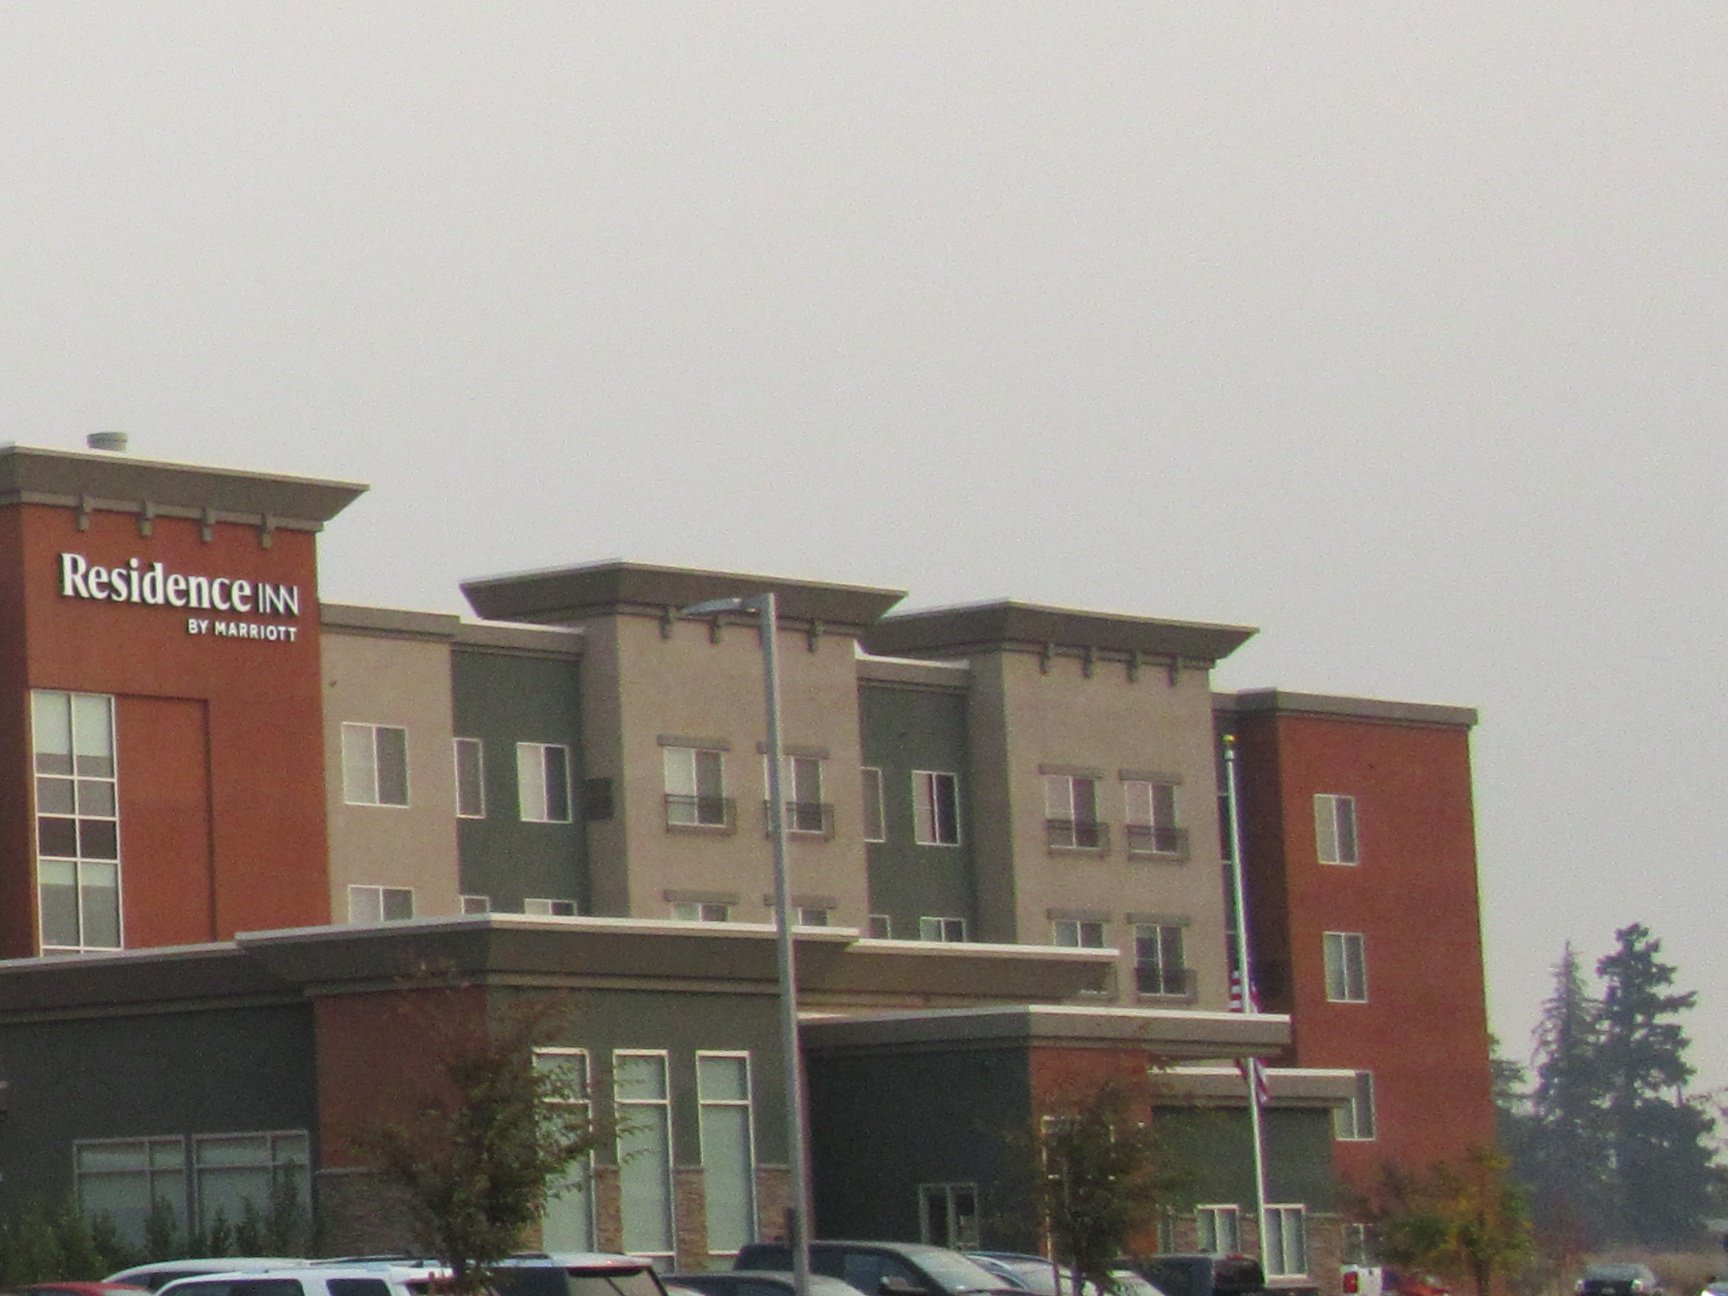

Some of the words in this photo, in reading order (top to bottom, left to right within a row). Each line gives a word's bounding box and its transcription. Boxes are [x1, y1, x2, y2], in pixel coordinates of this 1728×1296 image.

[60, 552, 251, 612] Residence
[258, 582, 299, 615] INN
[188, 618, 208, 635] BY
[215, 620, 297, 642] MARRIOTT
